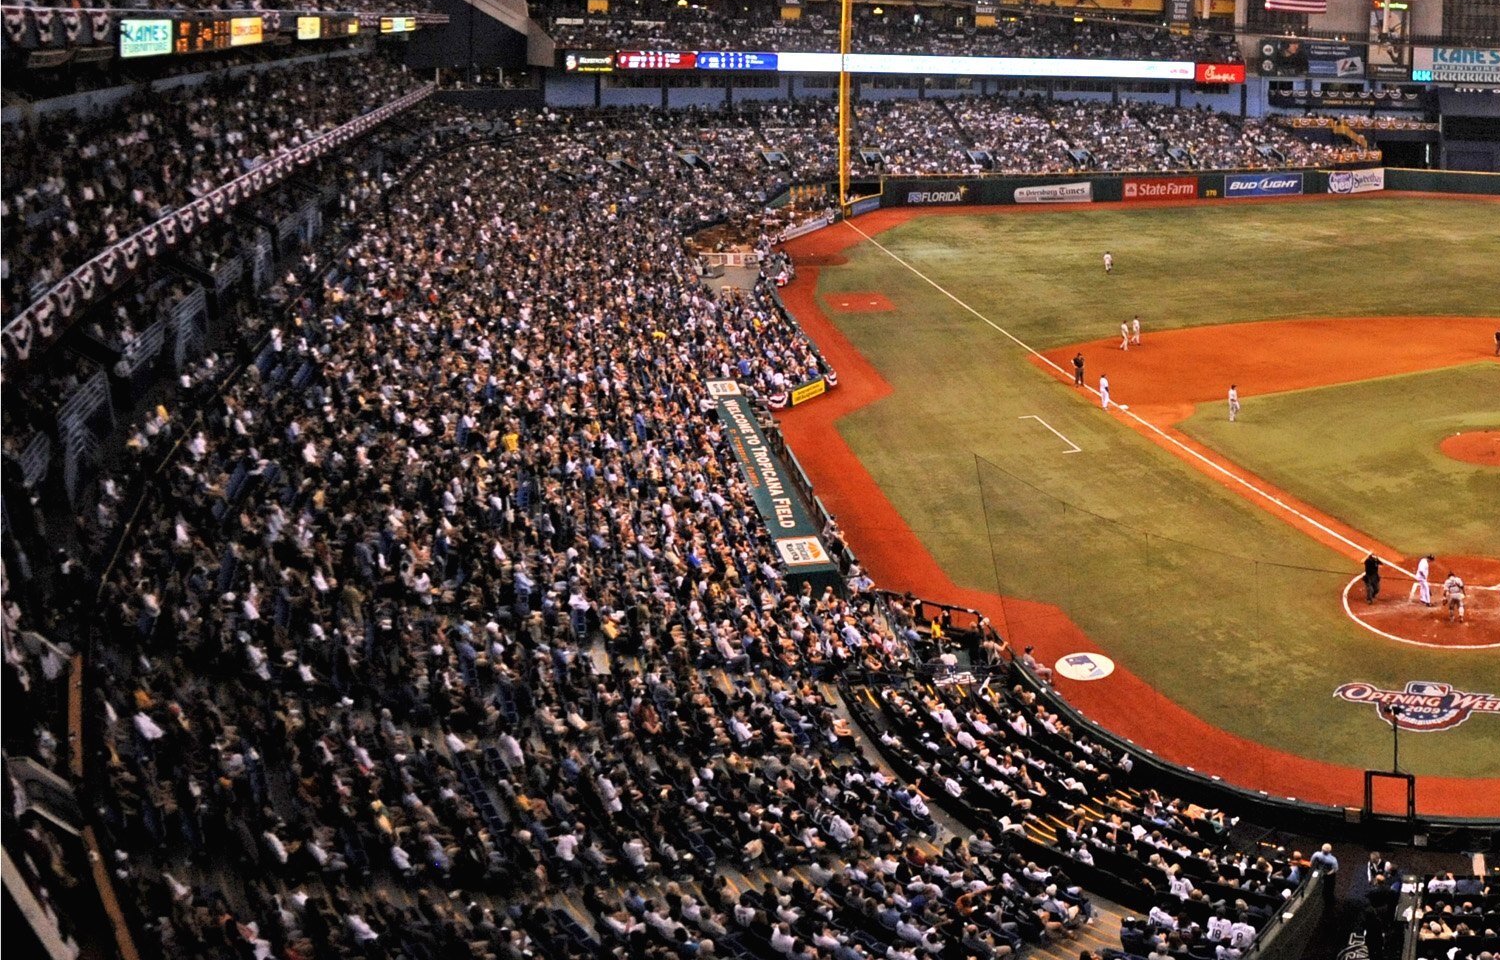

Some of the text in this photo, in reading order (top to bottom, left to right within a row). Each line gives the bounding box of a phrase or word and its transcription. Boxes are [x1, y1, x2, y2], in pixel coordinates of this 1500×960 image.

[1432, 64, 1500, 72] FURNITURE
[1229, 178, 1299, 190] BUD LIGHT
[922, 191, 961, 203] FLORIDA
[1058, 186, 1086, 196] Times
[723, 399, 754, 435] WELCOME
[745, 434, 761, 445] TO
[752, 446, 785, 497] TROPICANA
[772, 497, 796, 529] FIELD
[1345, 684, 1441, 708] OPENING
[1406, 705, 1440, 714] 2009
